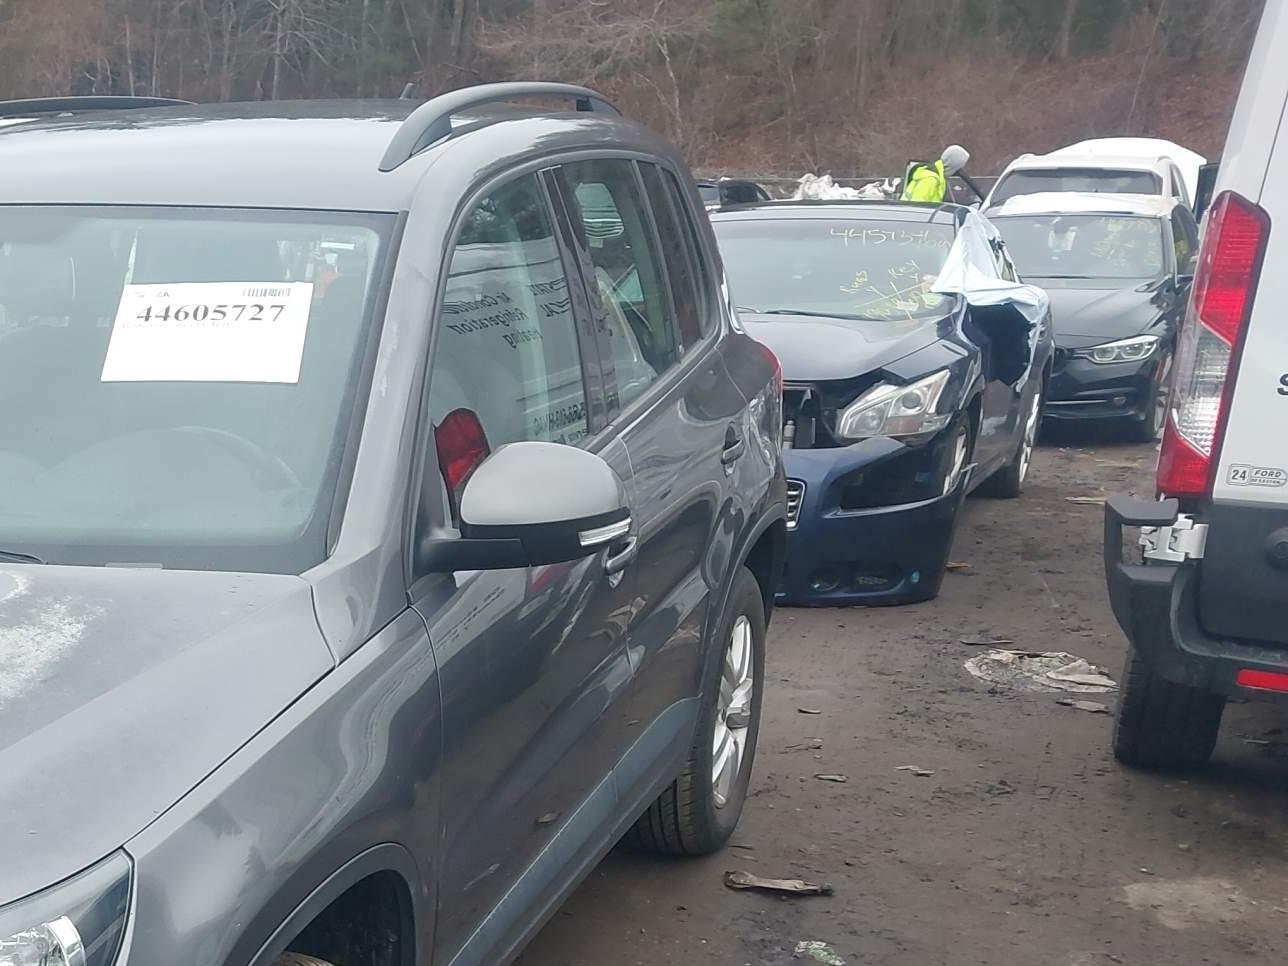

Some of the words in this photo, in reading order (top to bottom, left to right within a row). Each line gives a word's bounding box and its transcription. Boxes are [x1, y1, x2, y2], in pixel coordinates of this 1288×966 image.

[136, 303, 287, 322] 44605727
[1231, 469, 1247, 480] 24
[1254, 469, 1282, 478] FORD
